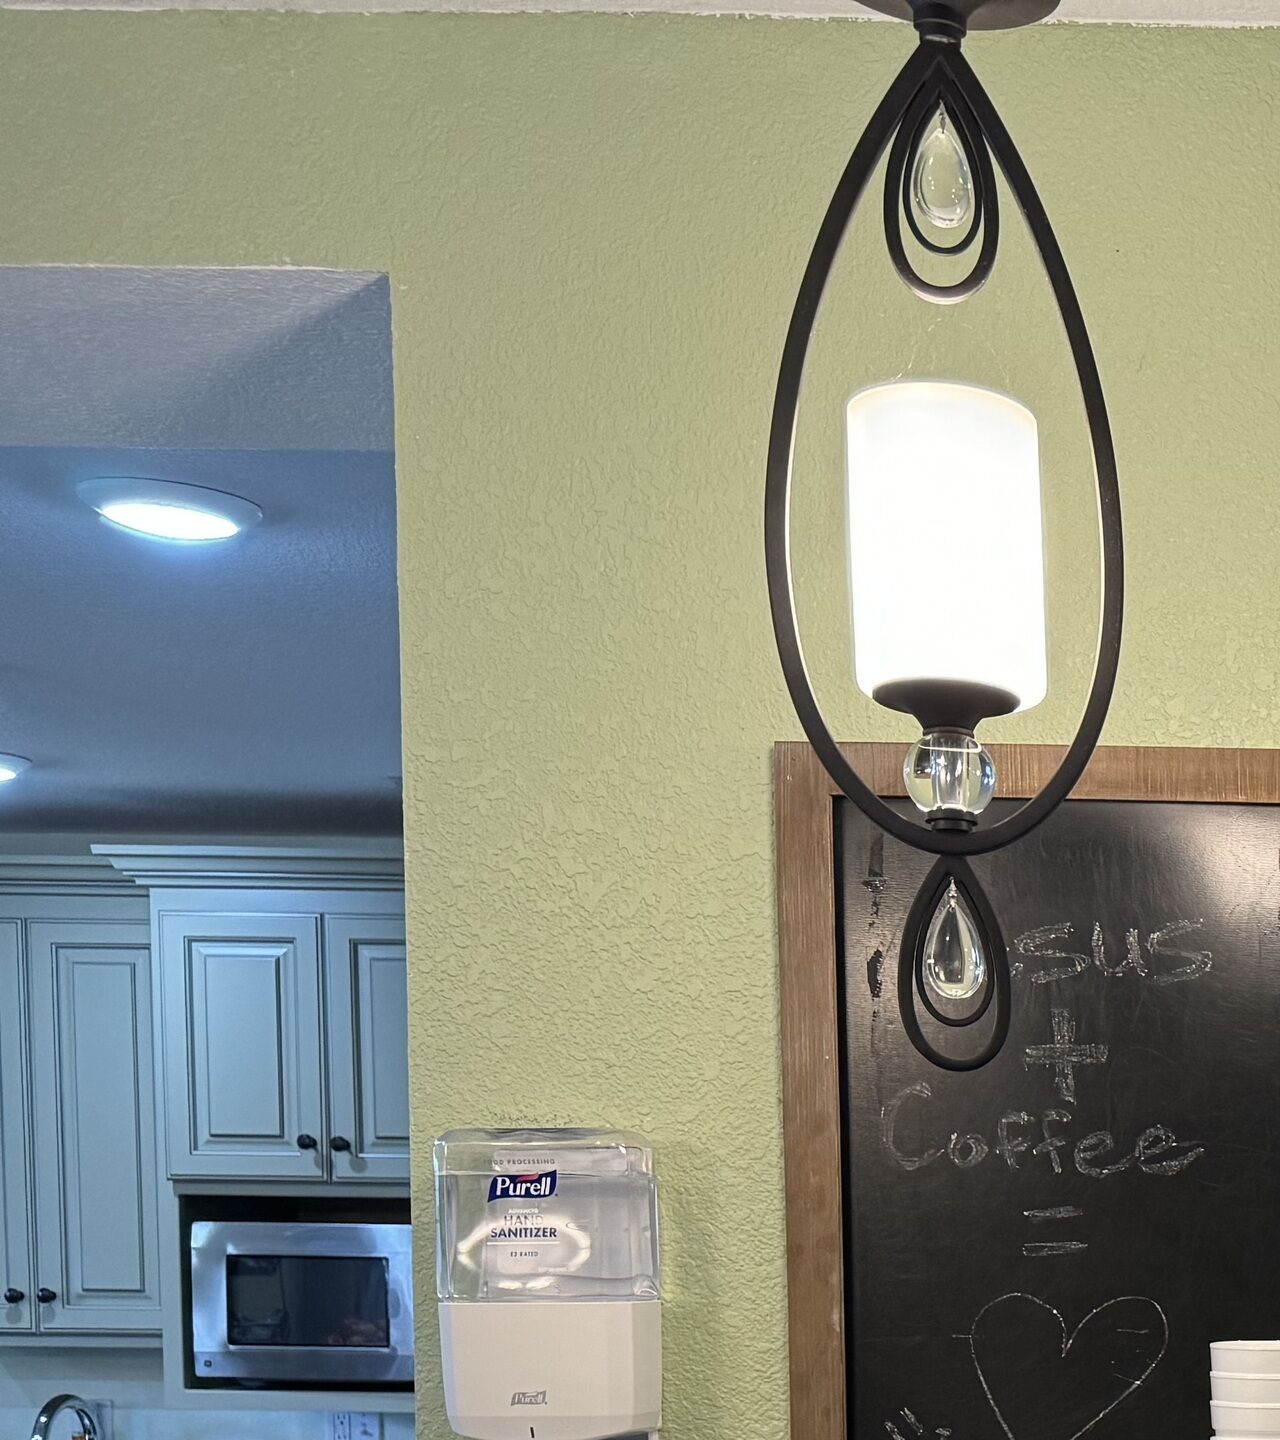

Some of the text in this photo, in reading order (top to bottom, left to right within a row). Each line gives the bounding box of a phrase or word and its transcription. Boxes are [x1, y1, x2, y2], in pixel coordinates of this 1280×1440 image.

[880, 1081, 1205, 1178] Coffee
[495, 1175, 551, 1197] Purell
[503, 1215, 544, 1226] HAND
[490, 1227, 557, 1239] SANITIZER
